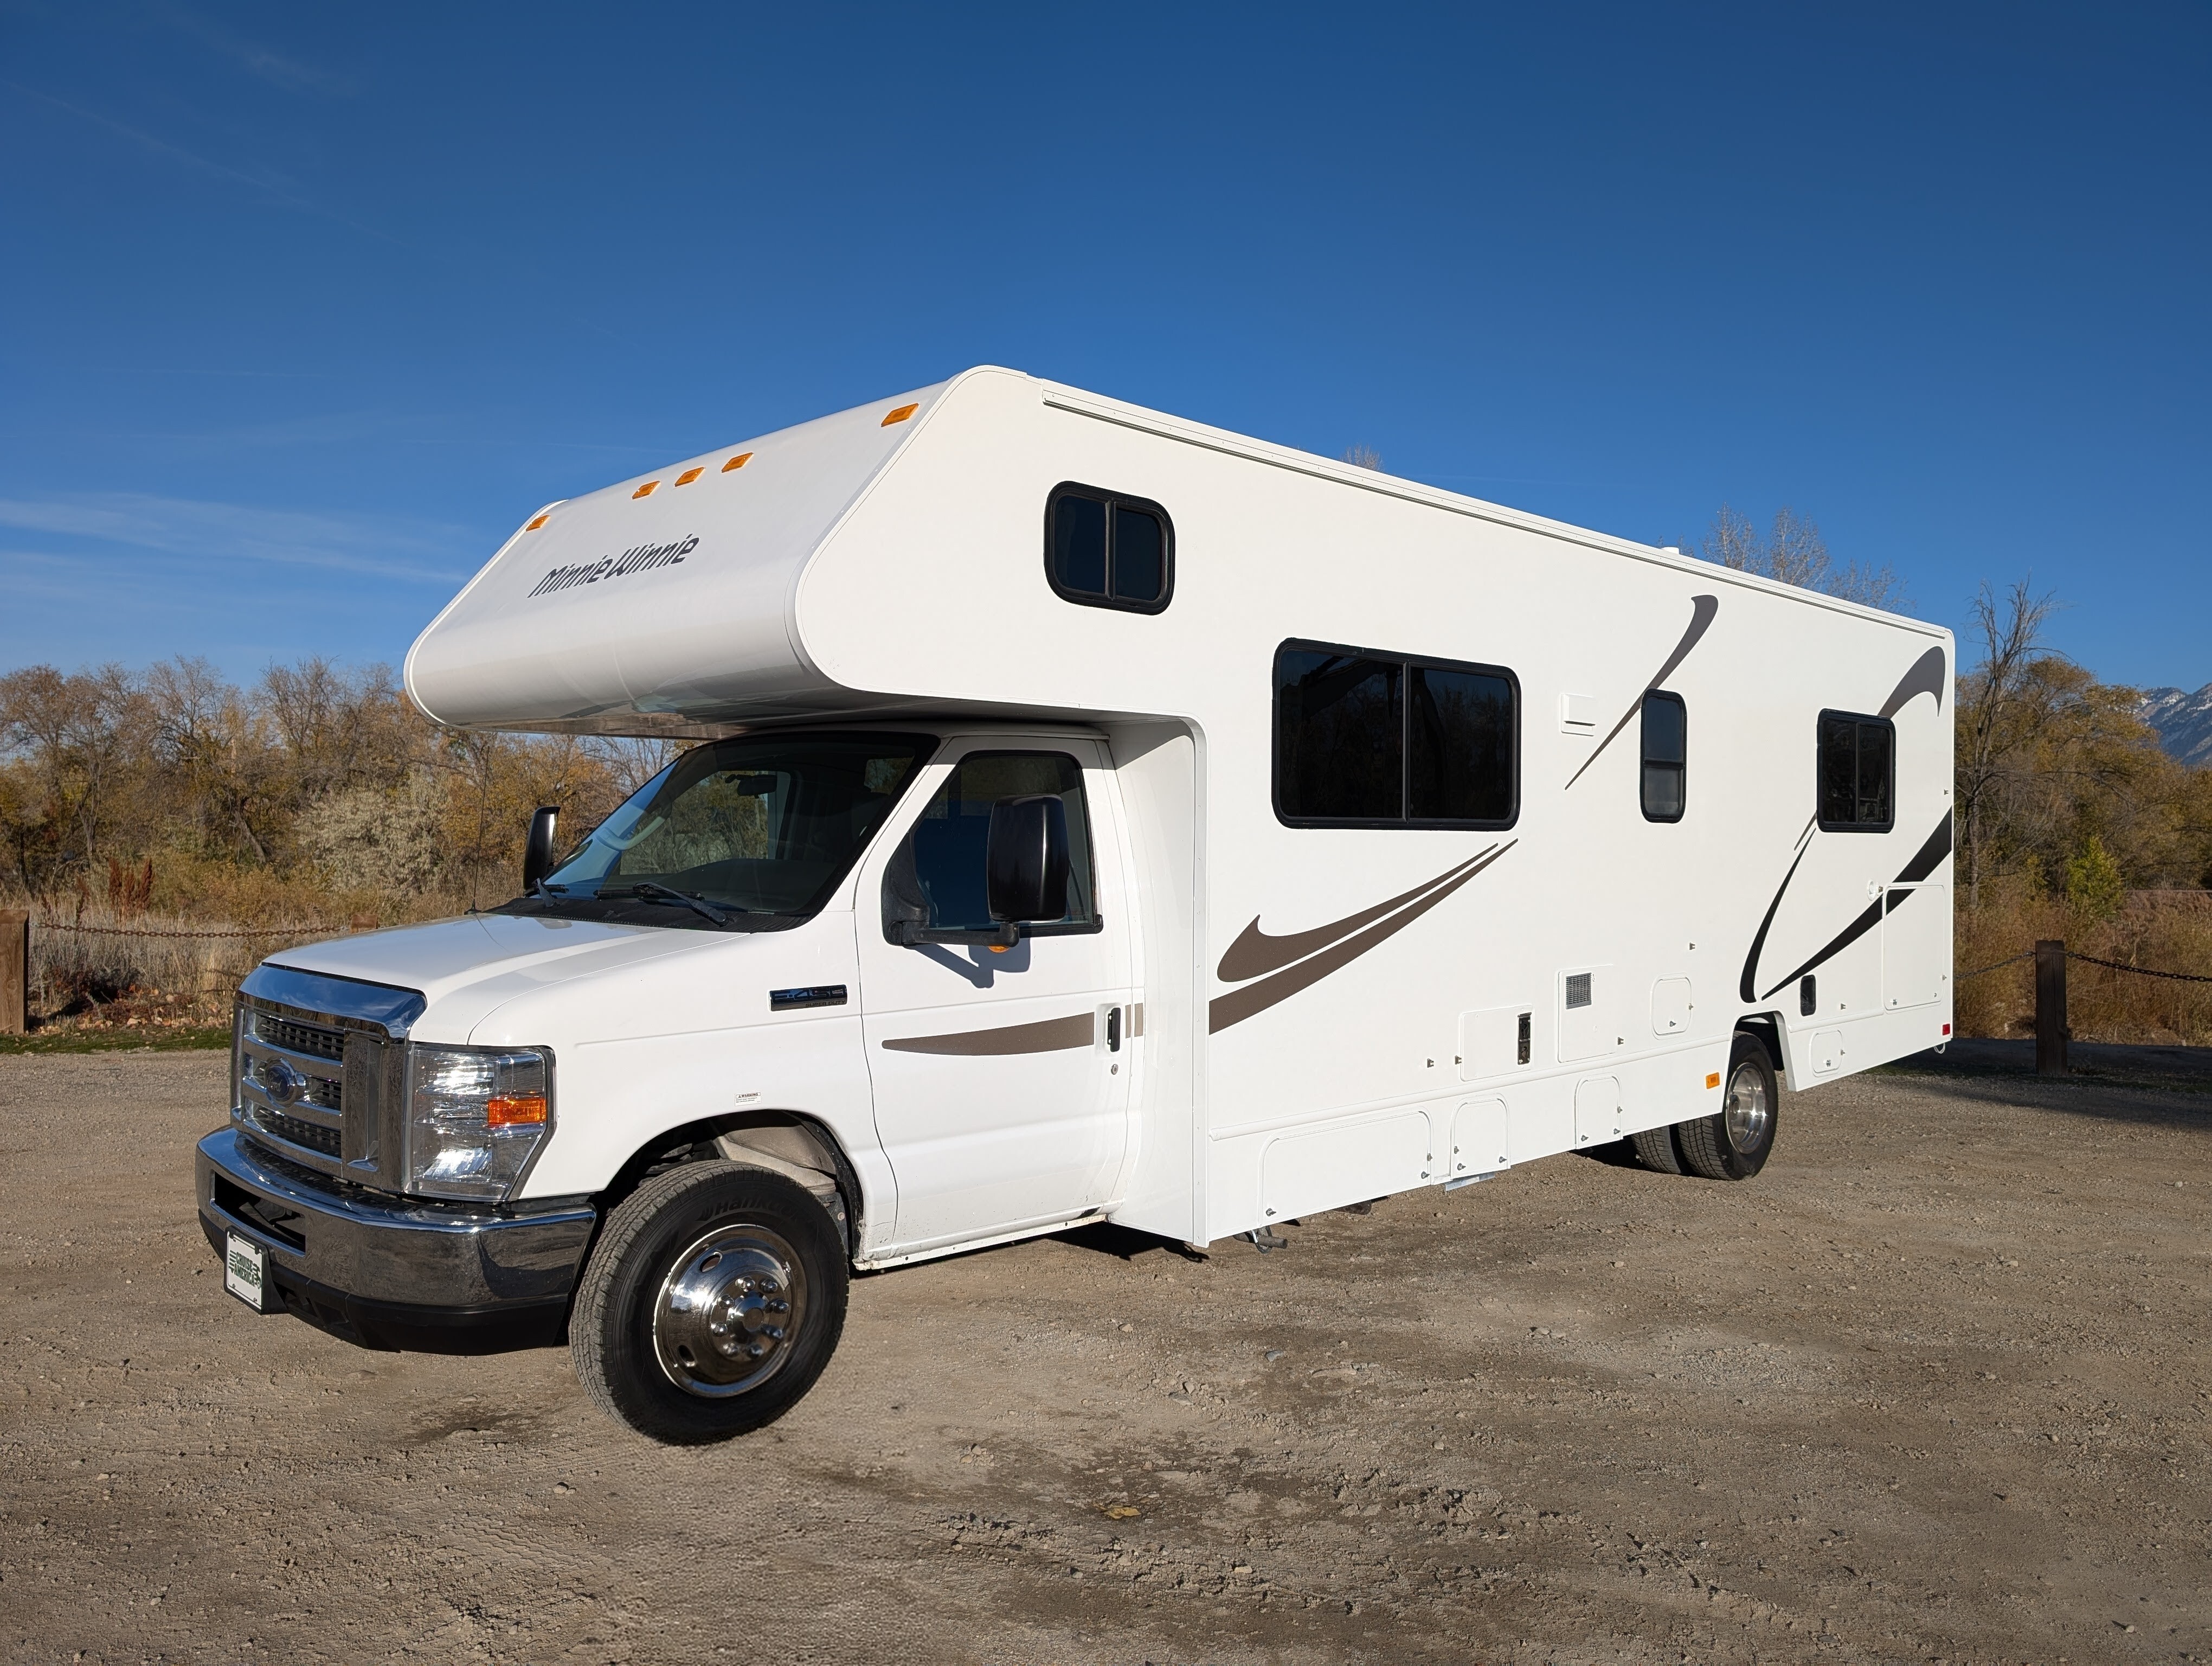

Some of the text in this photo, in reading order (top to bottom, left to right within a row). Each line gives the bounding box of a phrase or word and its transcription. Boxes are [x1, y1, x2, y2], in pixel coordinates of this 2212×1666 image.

[771, 986, 846, 1003] E-450
[236, 1251, 253, 1272] CRUISE
[234, 1263, 255, 1287] AMERICA
